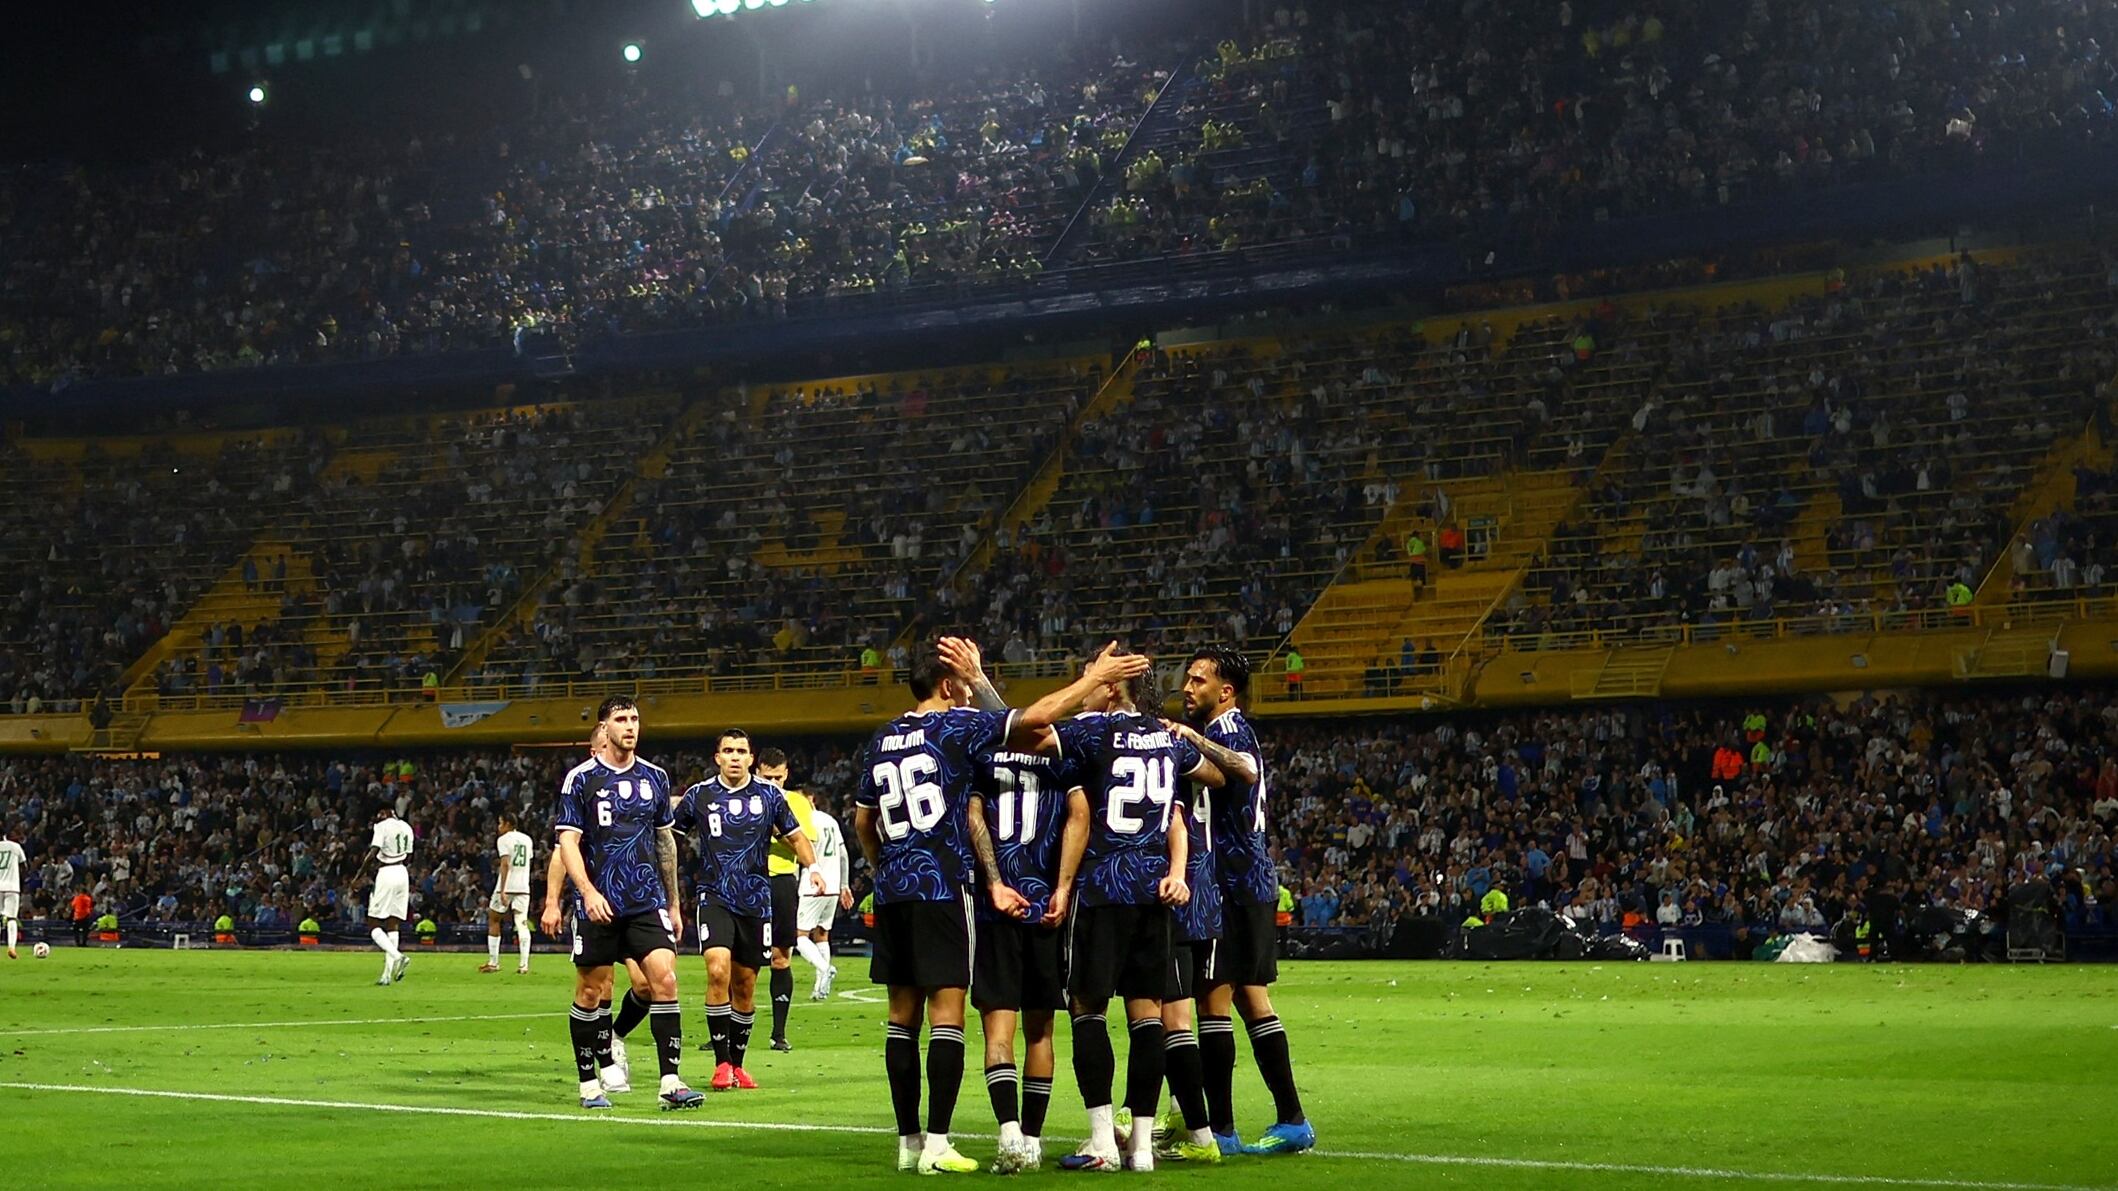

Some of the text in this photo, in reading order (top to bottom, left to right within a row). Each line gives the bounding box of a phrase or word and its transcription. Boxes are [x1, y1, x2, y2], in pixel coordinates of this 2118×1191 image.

[881, 729, 925, 752] MOLINA
[873, 753, 947, 840] 26
[994, 766, 1039, 845] 11
[1107, 756, 1175, 834] 24
[598, 801, 612, 826] 6
[708, 812, 722, 837] 8
[395, 833, 408, 854] 11
[512, 844, 527, 867] 29
[763, 922, 772, 946] 8
